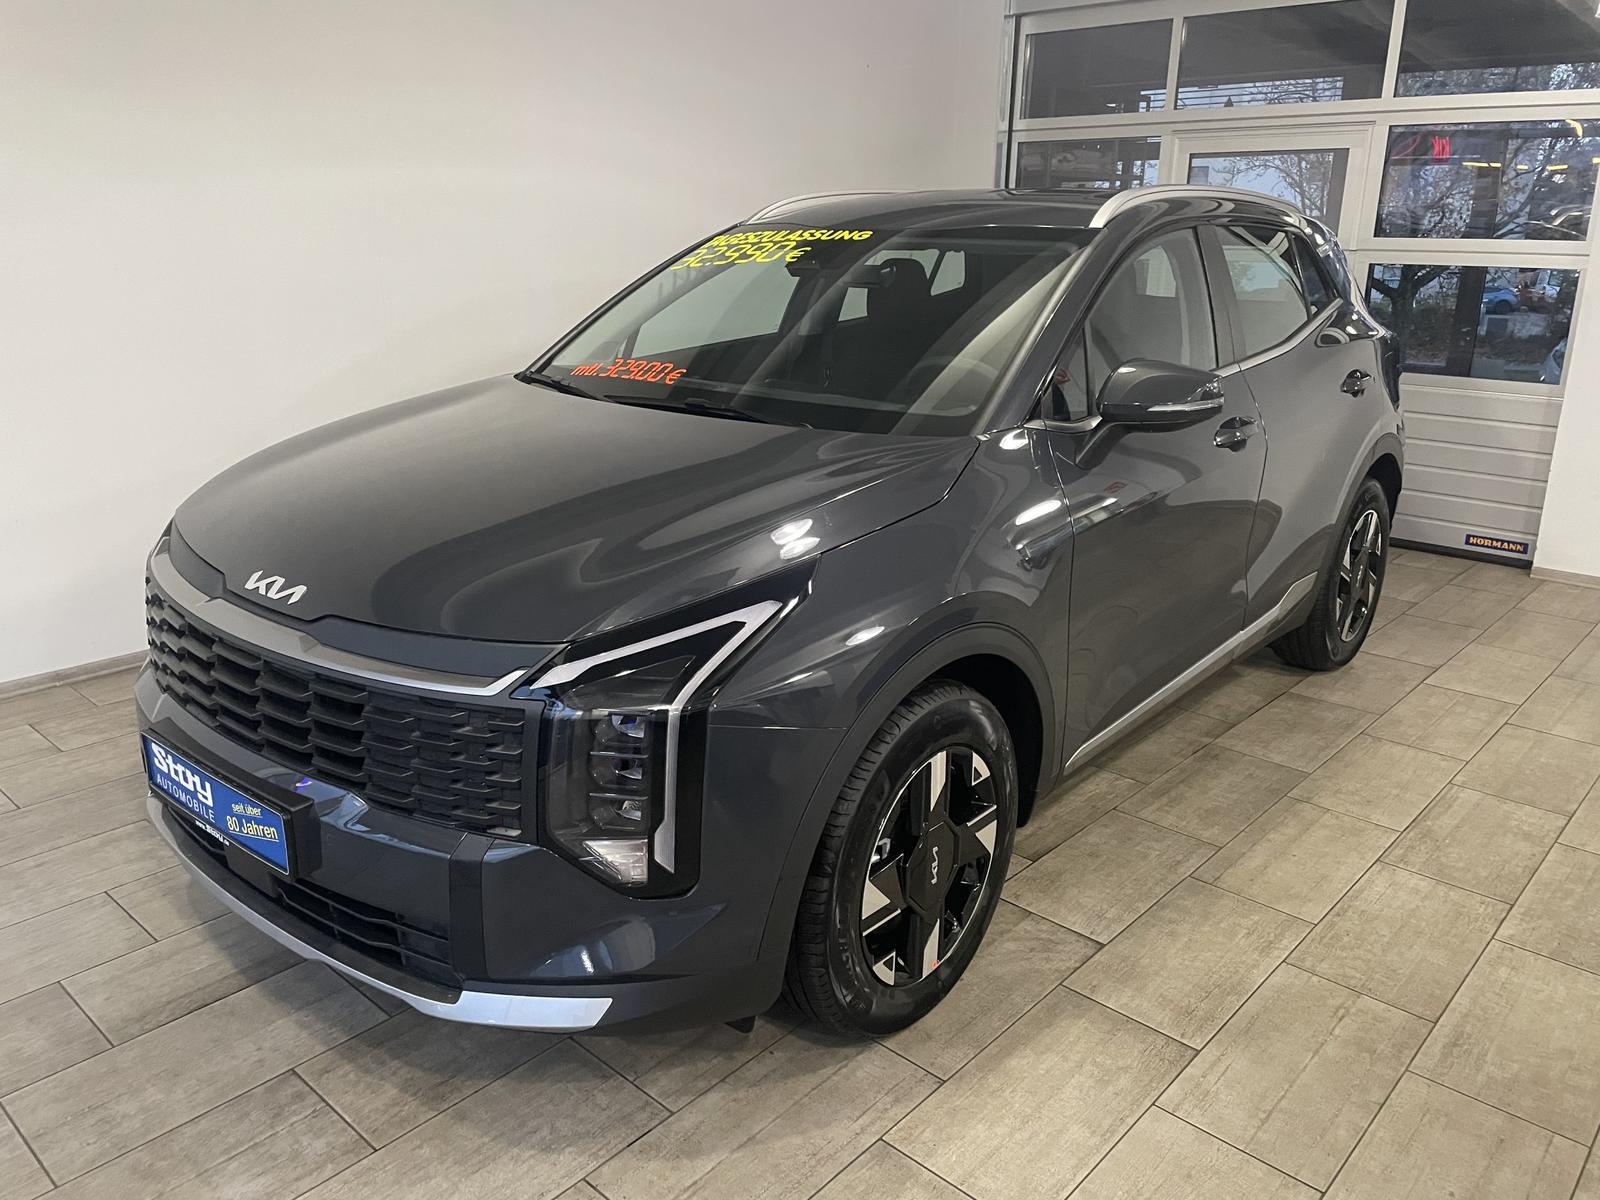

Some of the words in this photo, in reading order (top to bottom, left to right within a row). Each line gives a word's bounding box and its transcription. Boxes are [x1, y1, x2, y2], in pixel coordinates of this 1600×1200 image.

[784, 246, 813, 263] €
[665, 368, 688, 385] €
[246, 570, 307, 604] KIA
[157, 774, 216, 823] AUTOMOBILE
[231, 803, 246, 813] seit
[244, 804, 261, 816] über
[226, 815, 240, 832] 80
[242, 818, 278, 840] Jahren
